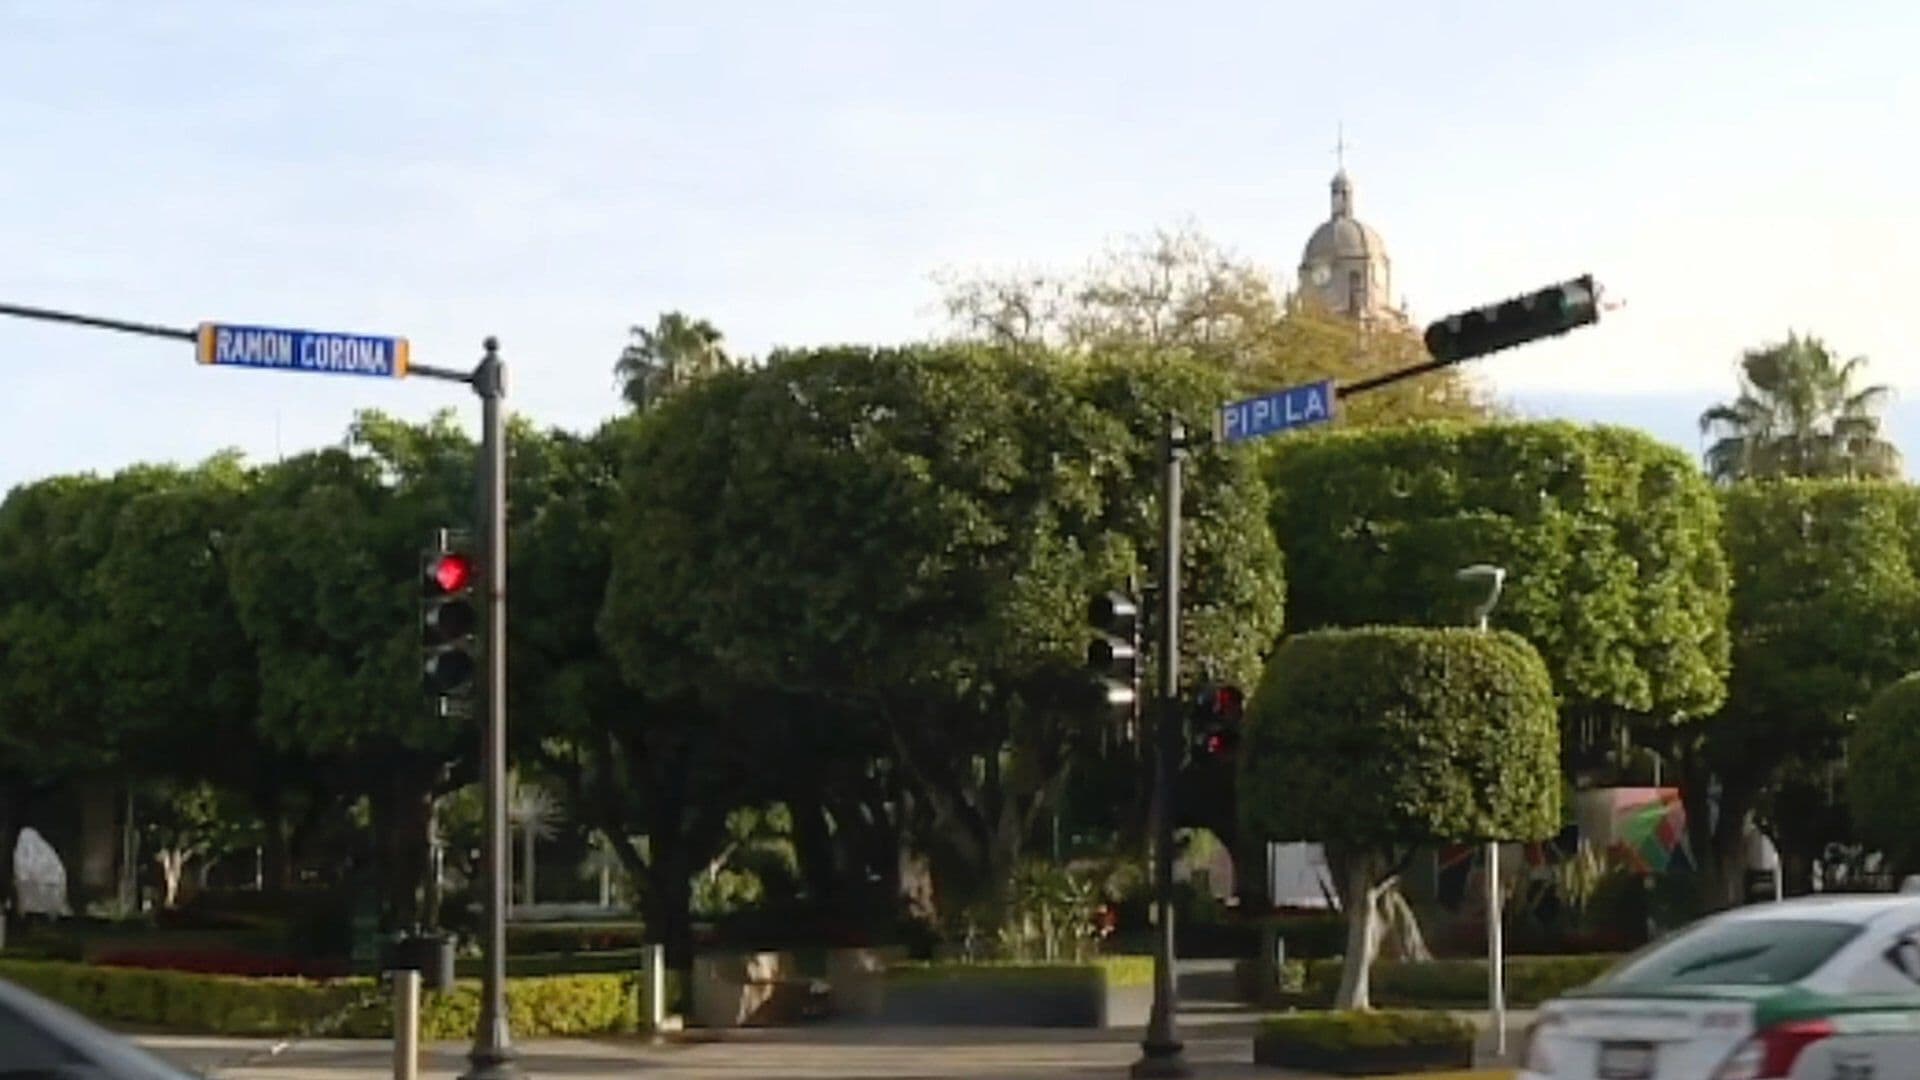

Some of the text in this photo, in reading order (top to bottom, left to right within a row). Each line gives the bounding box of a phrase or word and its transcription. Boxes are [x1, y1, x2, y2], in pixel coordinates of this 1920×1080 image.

[216, 328, 388, 373] RAMON CORONA
[1223, 388, 1325, 437] PIPILA
